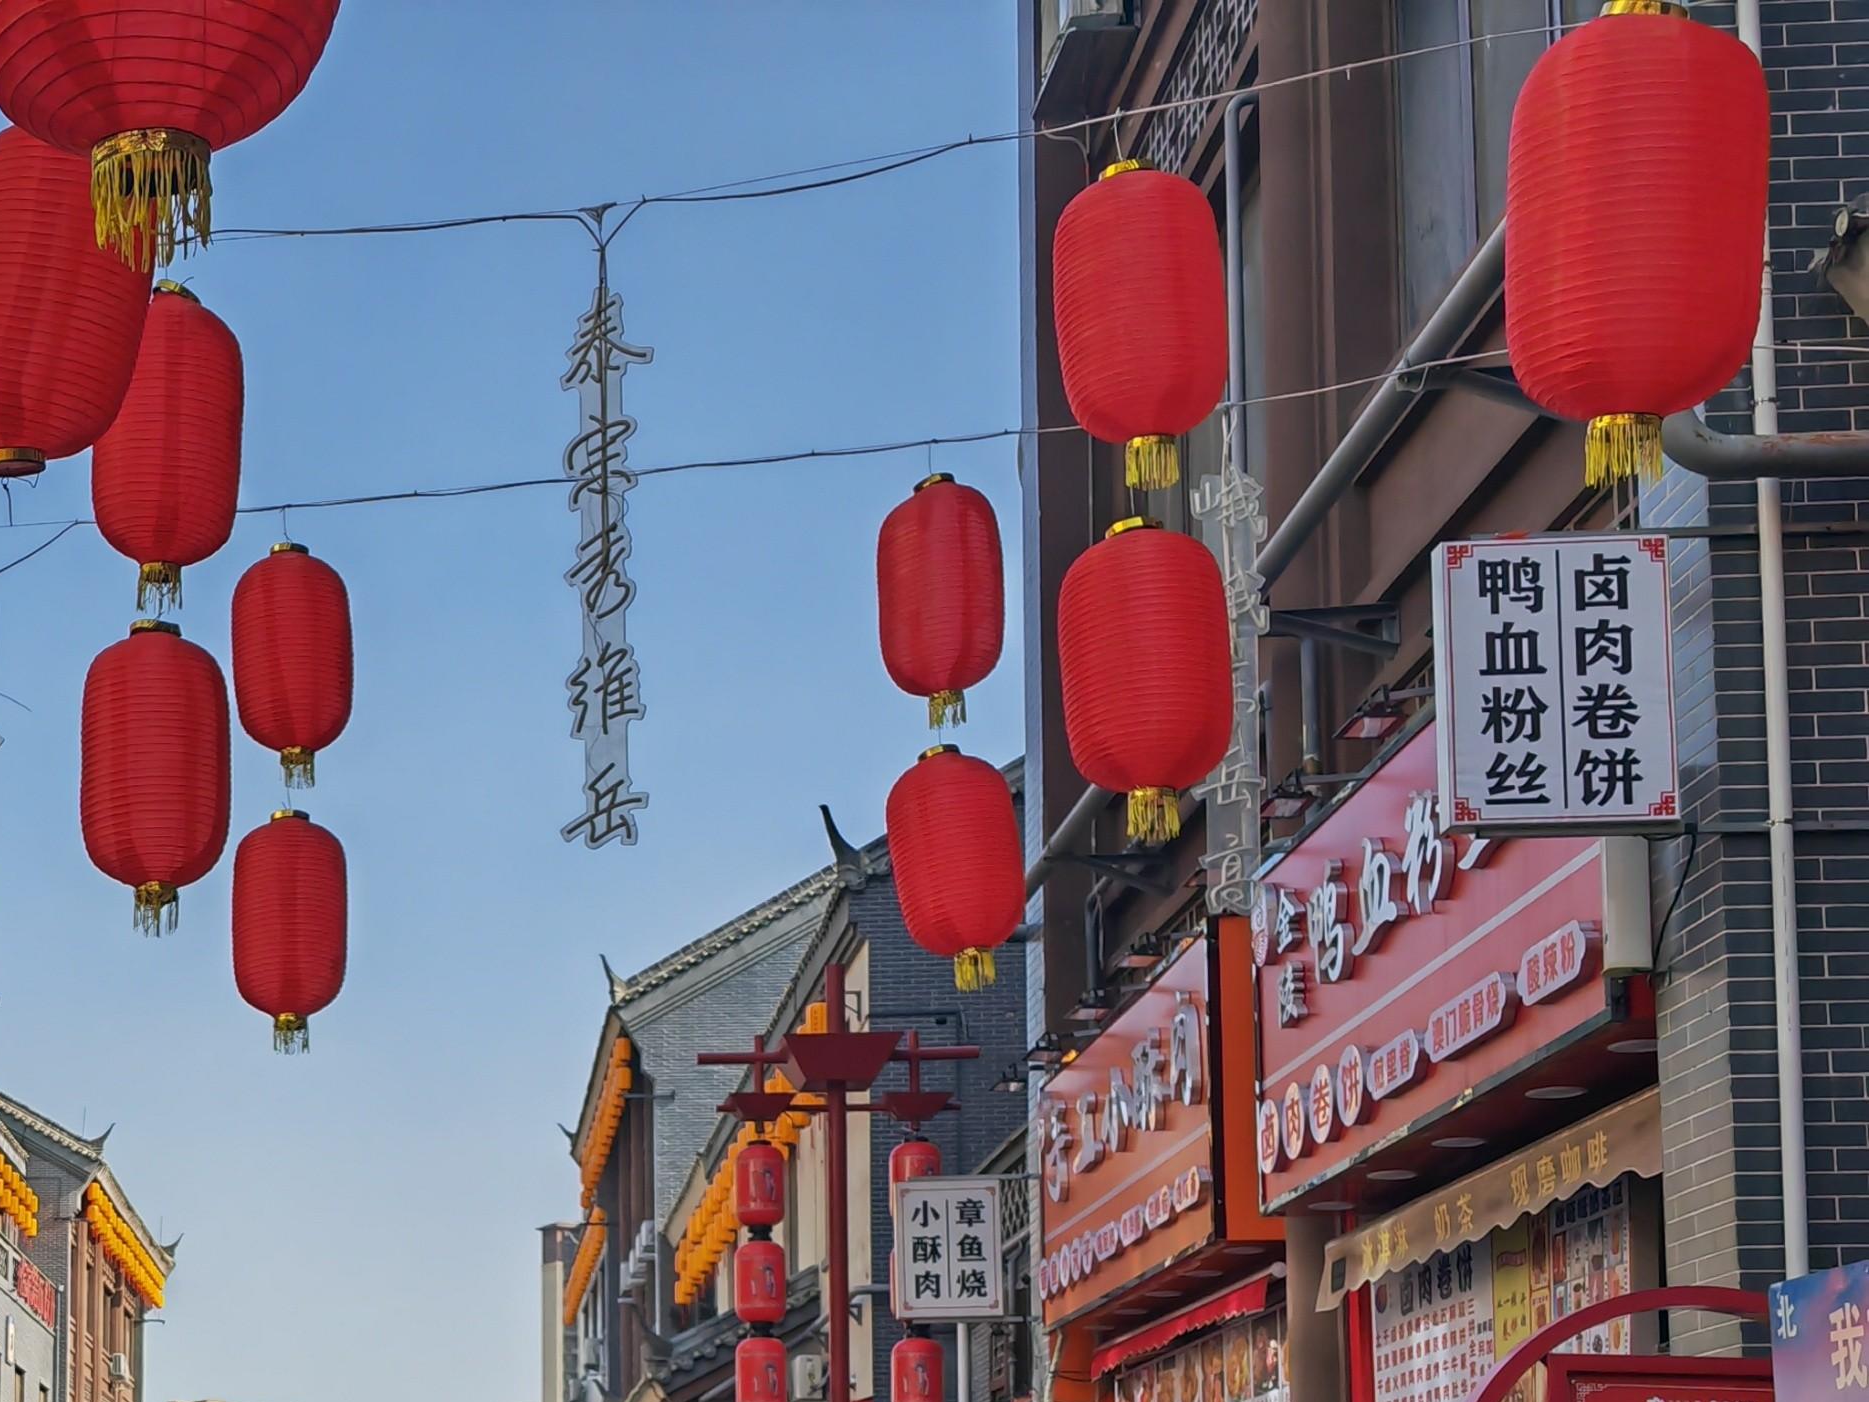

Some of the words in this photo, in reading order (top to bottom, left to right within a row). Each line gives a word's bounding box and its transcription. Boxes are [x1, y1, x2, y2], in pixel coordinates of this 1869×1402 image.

[1478, 556, 1551, 806] 鸭血粉丝
[1572, 553, 1644, 807] 卤肉卷饼
[1307, 790, 1493, 983] 鸭血粉
[1275, 888, 1305, 1026] 金陵
[1526, 938, 1576, 995] 酸辣粉
[1046, 990, 1202, 1203] 手工小酥肉
[1261, 1054, 1361, 1163] 卤肉卷饼
[1434, 1192, 1474, 1241] 奶茶
[1510, 1130, 1608, 1207] 现磨咖啡
[911, 1200, 942, 1299] 小酥肉
[955, 1198, 987, 1299] 章鱼烧
[1361, 1222, 1409, 1273] 冰淇淋
[1777, 1295, 1798, 1340] 北
[1829, 1302, 1869, 1390] 我
